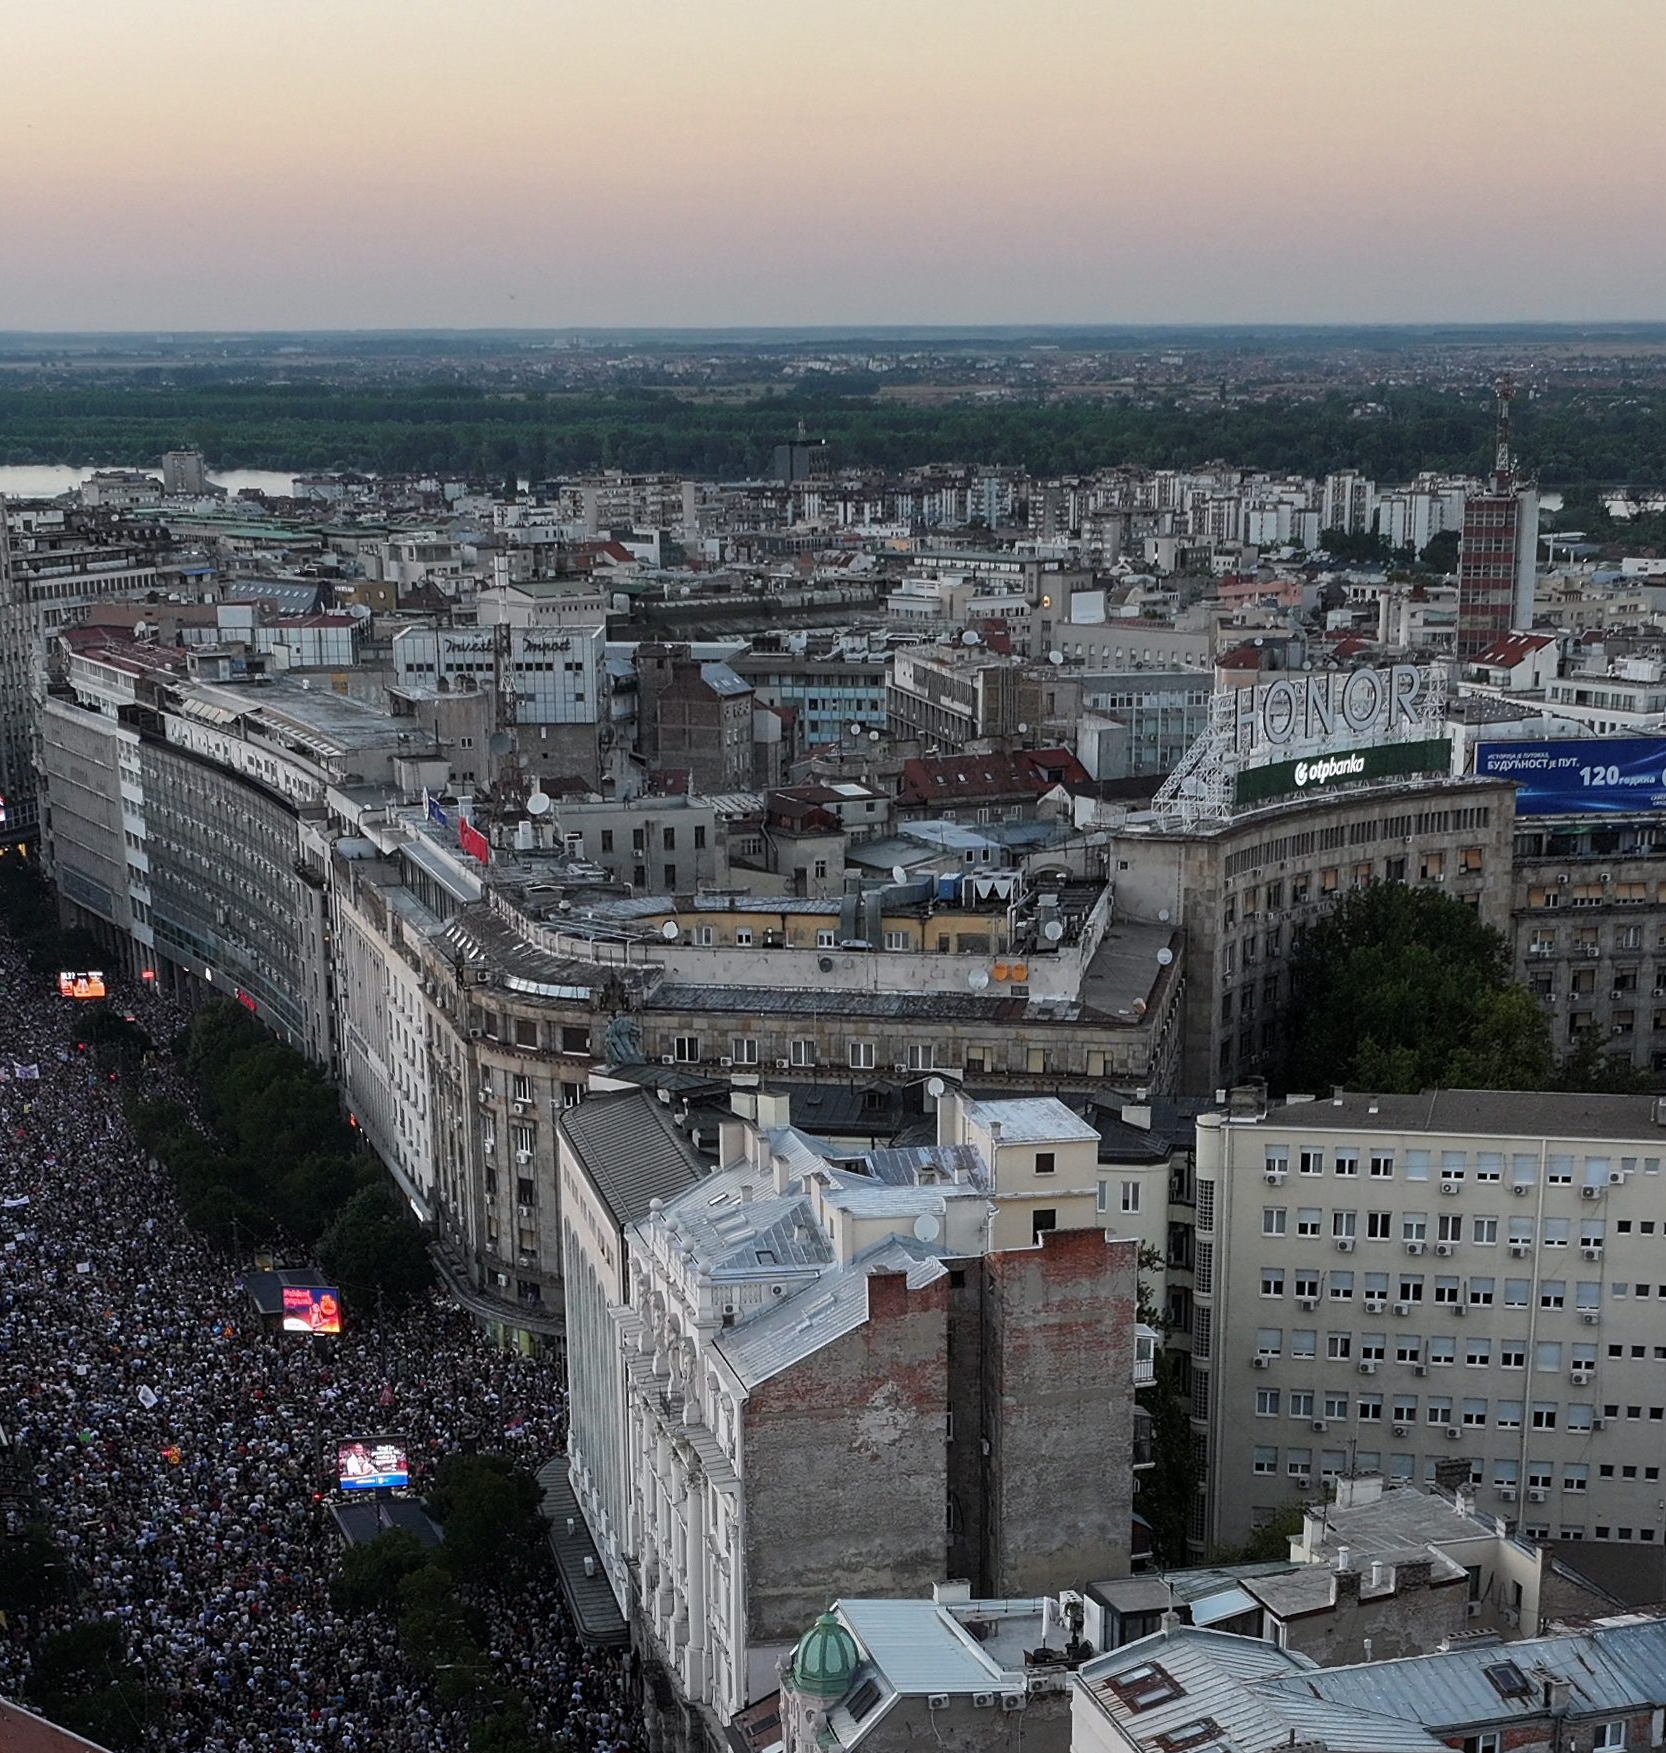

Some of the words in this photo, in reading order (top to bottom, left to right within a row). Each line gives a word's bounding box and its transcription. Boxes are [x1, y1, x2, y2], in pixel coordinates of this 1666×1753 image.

[445, 638, 494, 652] Invest
[523, 638, 572, 656] Import
[1234, 665, 1421, 753] HONOR
[1487, 759, 1548, 772] БУДУЋНОСТ
[1579, 765, 1619, 786] 120
